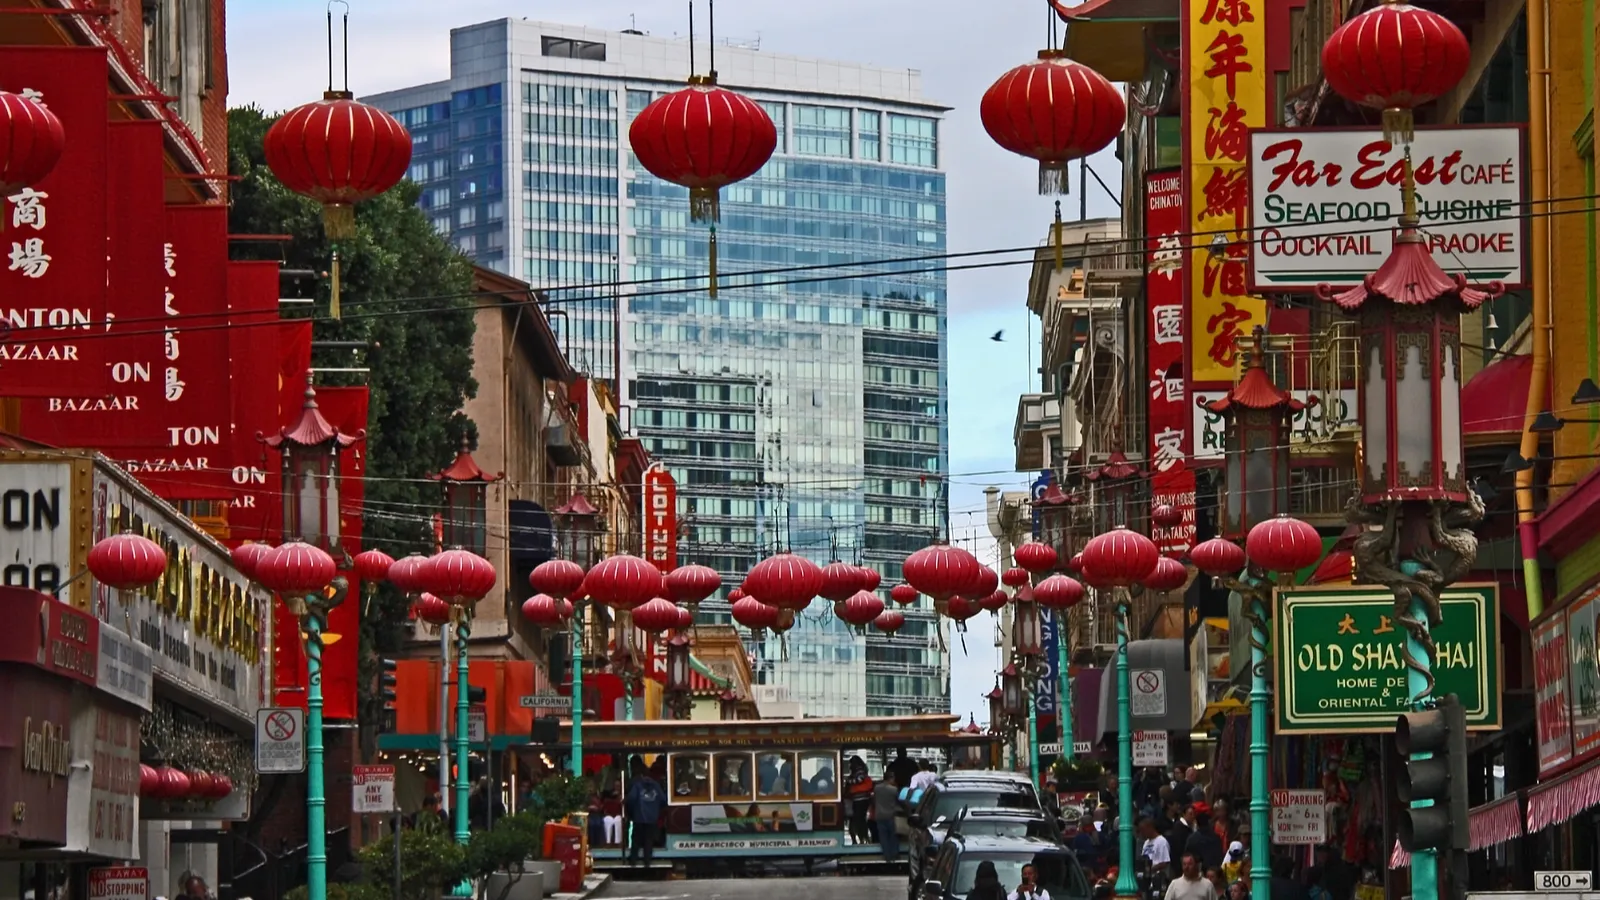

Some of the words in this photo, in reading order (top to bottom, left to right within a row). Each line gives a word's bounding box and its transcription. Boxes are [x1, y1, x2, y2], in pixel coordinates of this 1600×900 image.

[1262, 139, 1341, 192] Far
[1350, 140, 1463, 189] East
[1460, 158, 1515, 185] CAFÉ
[1147, 177, 1180, 194] WELCOME
[1260, 227, 1382, 256] COCKTAIL
[0, 308, 91, 331] NTON
[49, 396, 139, 412] BAZAAR
[167, 425, 219, 446] TON
[127, 457, 209, 473] BAZAAR
[232, 466, 266, 484] ON
[1298, 643, 1343, 672] OLD
[1352, 641, 1474, 671] SHAHAI
[1337, 677, 1377, 688] HOME
[1381, 687, 1390, 698] &
[1318, 697, 1387, 709] ORIENTAL
[366, 785, 382, 794] ANY
[365, 795, 383, 805] TIME
[1273, 791, 1288, 806] NO
[1289, 794, 1323, 806] PARKING
[90, 880, 105, 897] NO
[106, 882, 145, 896] STOPPING
[1542, 874, 1572, 888] 800
